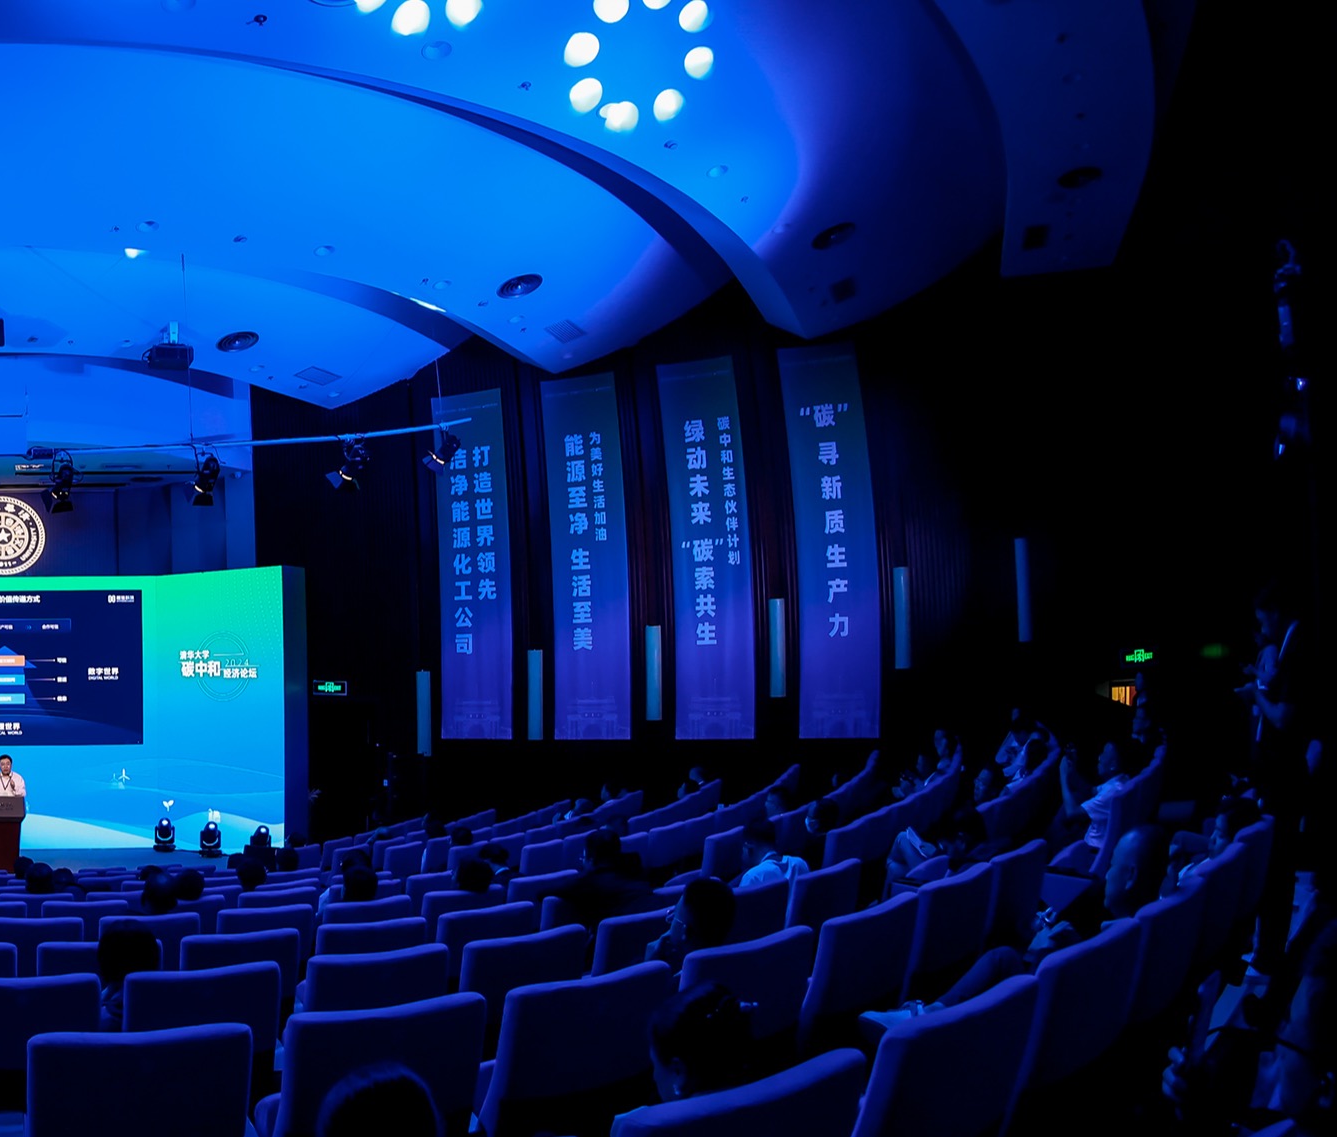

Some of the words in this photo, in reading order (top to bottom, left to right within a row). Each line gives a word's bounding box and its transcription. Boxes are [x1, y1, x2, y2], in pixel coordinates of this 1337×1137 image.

[472, 445, 497, 600] 打造世界领先
[564, 434, 589, 535] 能源至净
[589, 431, 607, 541] 为美好生活加油
[684, 419, 712, 525] 绿动未来
[717, 416, 740, 565] 碳中和生态伙伴计划
[570, 548, 593, 651] 生活至美
[180, 650, 210, 660] 清华大学
[181, 661, 221, 677] 碳中和
[223, 668, 257, 678] 经济论坛
